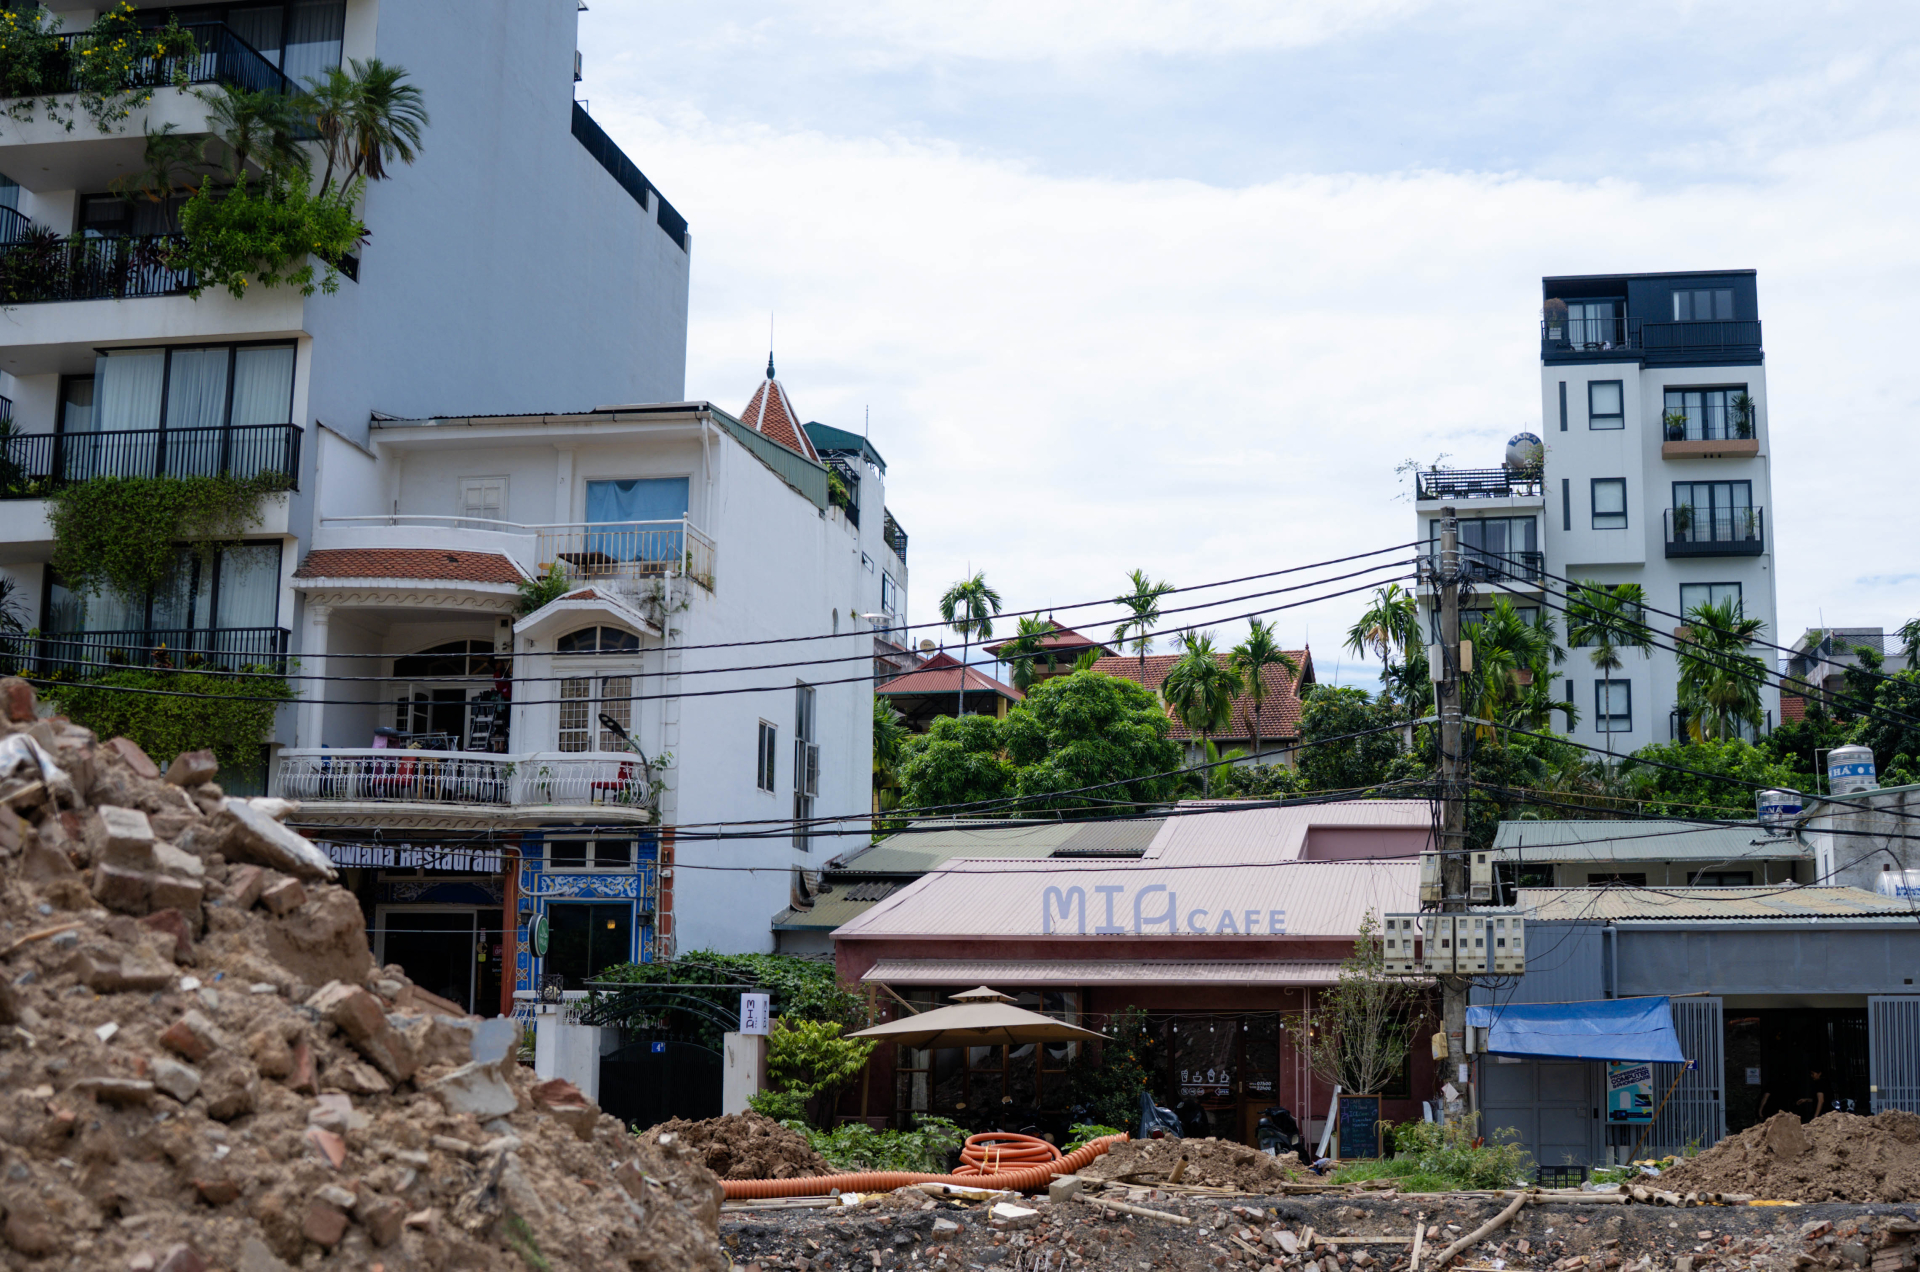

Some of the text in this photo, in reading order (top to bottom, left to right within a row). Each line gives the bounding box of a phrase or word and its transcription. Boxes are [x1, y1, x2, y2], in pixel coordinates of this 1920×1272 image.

[400, 844, 501, 872] Restaurant
[1043, 884, 1286, 934] MIA CAFE
[746, 1000, 755, 1029] MIA
[1611, 1070, 1650, 1084] COMPUTER
